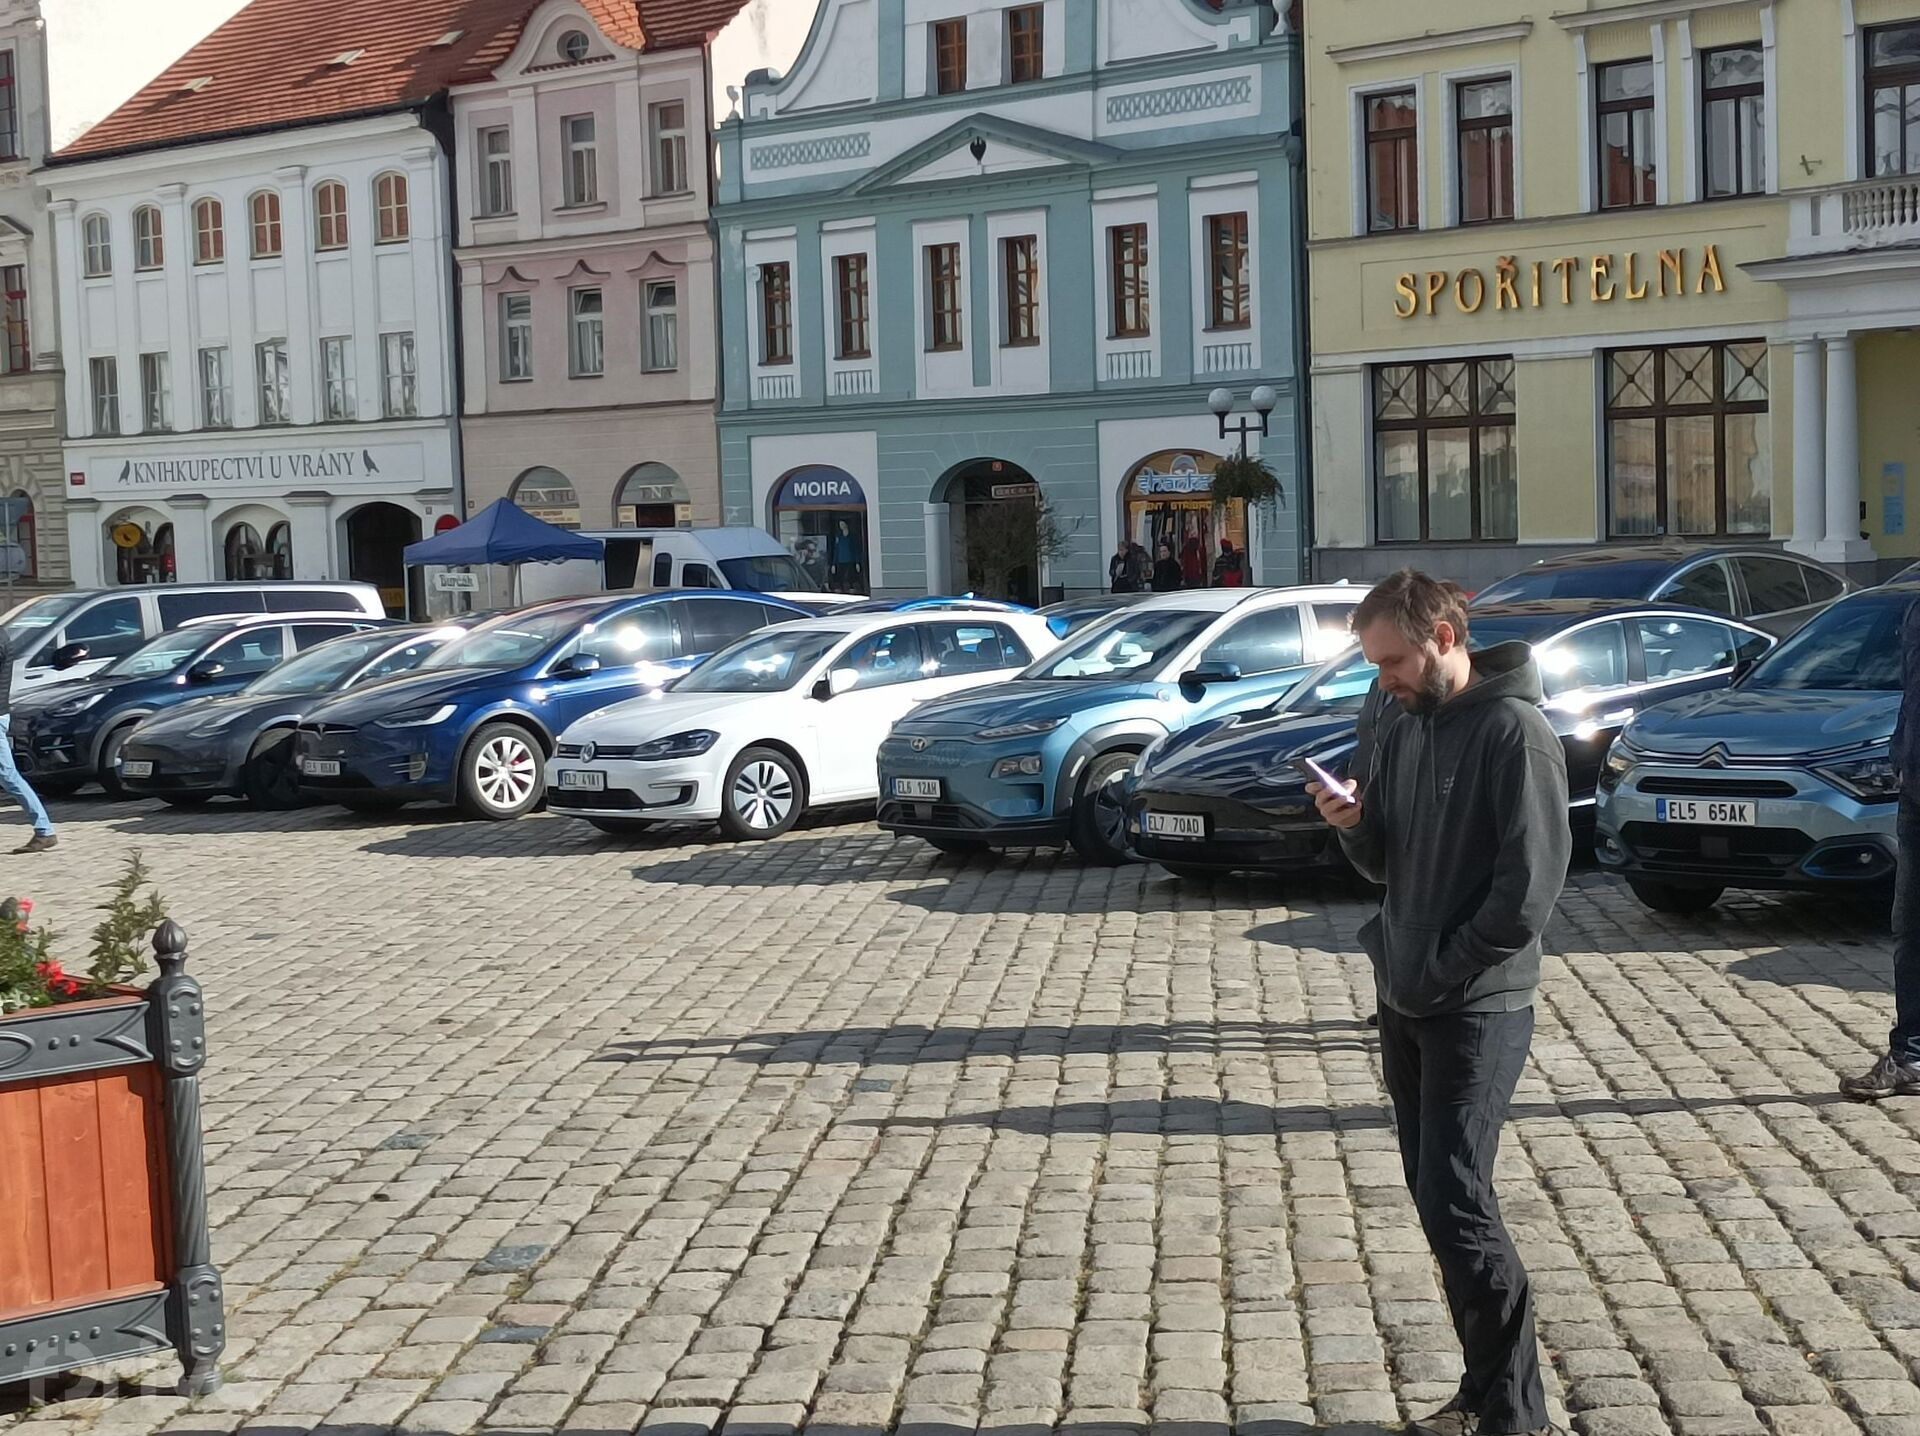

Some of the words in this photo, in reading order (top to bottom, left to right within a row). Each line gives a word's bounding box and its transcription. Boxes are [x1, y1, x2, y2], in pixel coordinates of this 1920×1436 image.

[1393, 244, 1726, 318] SPOŘITELNA
[134, 451, 264, 484] KNIHKUPECTVÍ
[270, 455, 282, 479] U
[288, 447, 355, 477] VRÁNY
[793, 480, 851, 497] MOIRA
[897, 779, 912, 797] EL6
[917, 780, 937, 797] 12AH
[1669, 801, 1697, 821] EL5
[1708, 803, 1747, 822] 65AK
[1149, 816, 1165, 832] EL7
